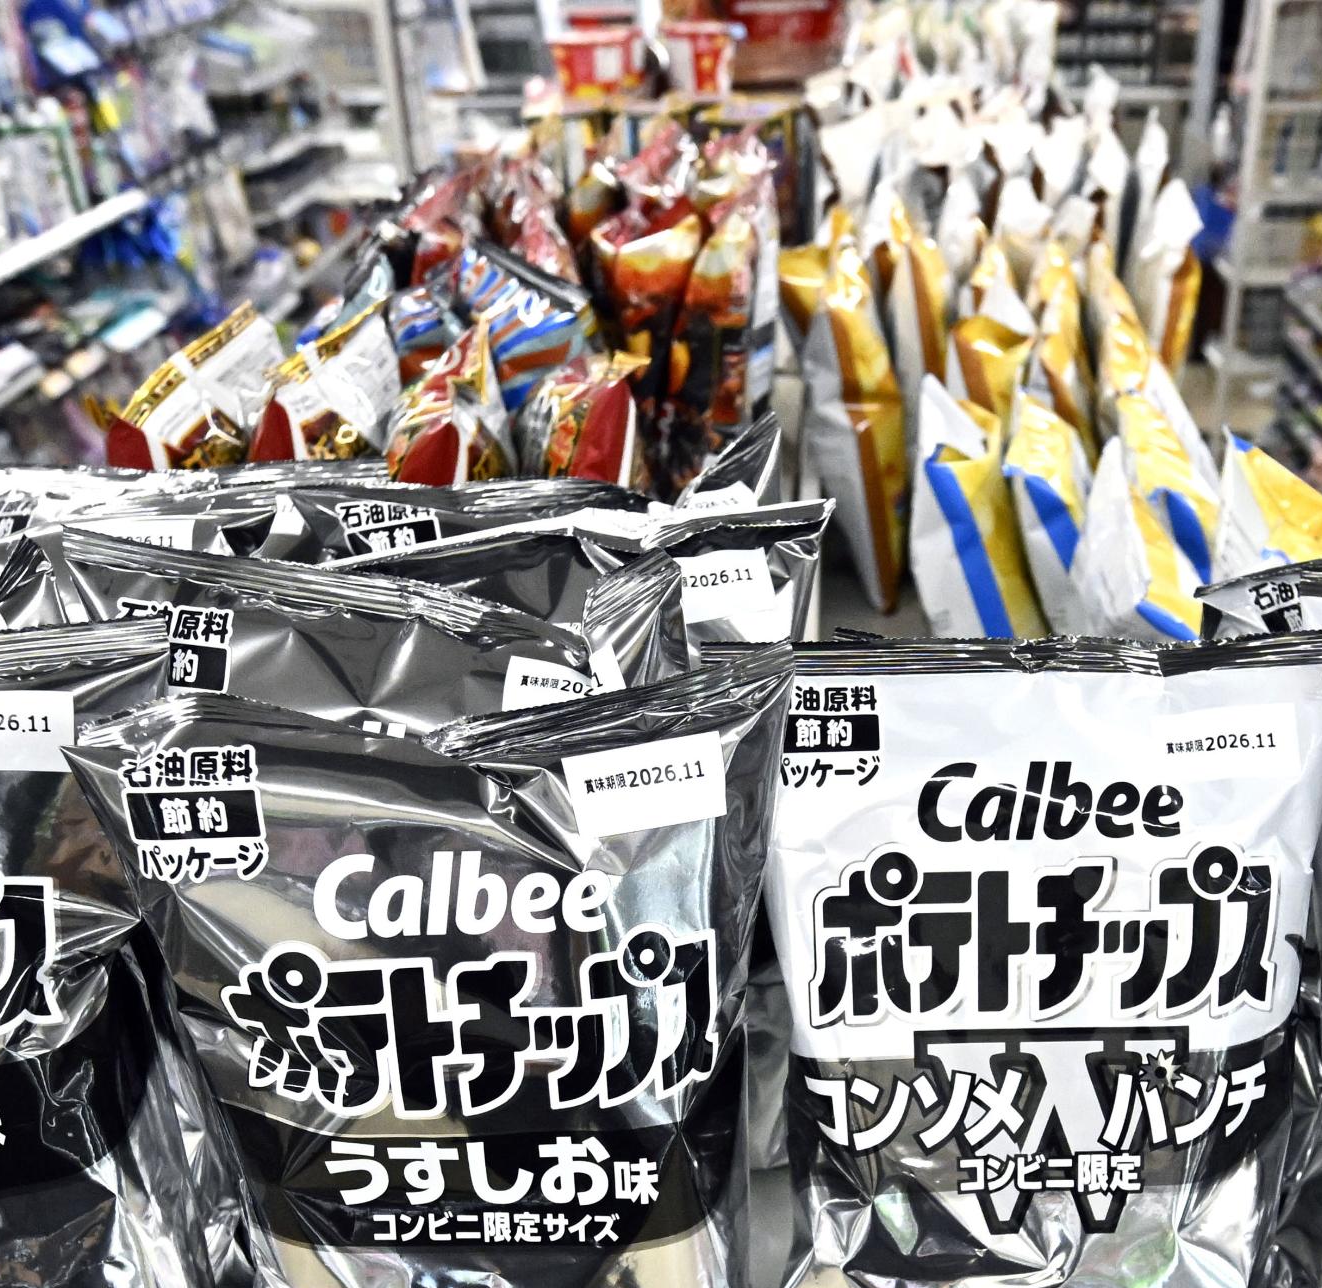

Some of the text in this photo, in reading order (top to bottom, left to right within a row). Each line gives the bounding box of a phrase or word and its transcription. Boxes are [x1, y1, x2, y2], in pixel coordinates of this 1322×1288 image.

[789, 685, 877, 714] 油原料
[795, 718, 854, 748] 節約
[1165, 732, 1277, 756] 賞味期限2026.11
[123, 747, 254, 788] 石油原料
[584, 760, 706, 795] 賞味期限2026.11
[159, 800, 229, 836] 節約
[917, 760, 1184, 843] Calbee
[140, 845, 266, 882] パッケージ
[312, 850, 611, 940] Calbee
[813, 843, 1279, 1026] ポテトチップス
[220, 923, 719, 1119] ポテトチップス
[324, 1135, 660, 1206] うすしお味
[958, 1153, 1144, 1195] コンビニ限定
[372, 1210, 620, 1244] コンビニ限定サイズ
